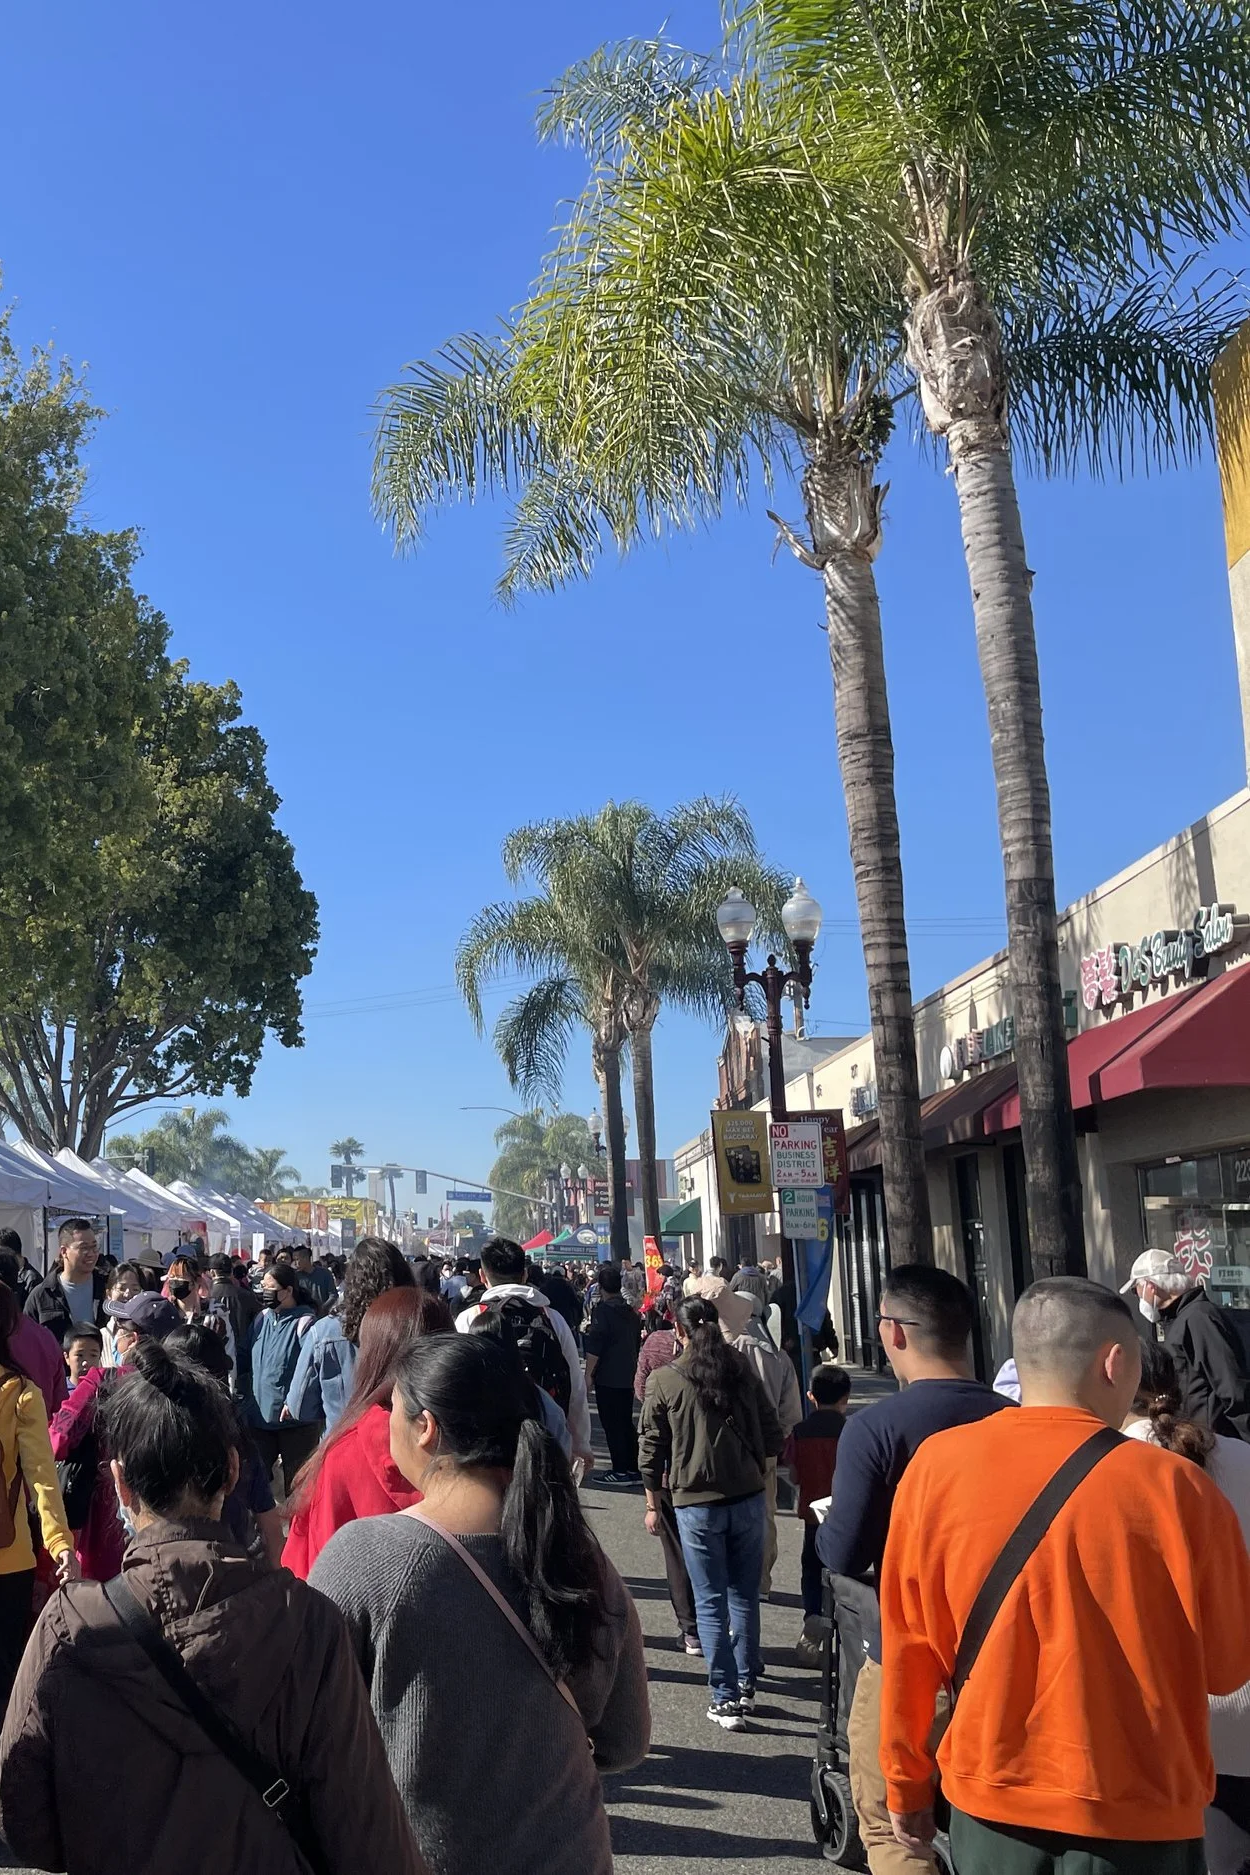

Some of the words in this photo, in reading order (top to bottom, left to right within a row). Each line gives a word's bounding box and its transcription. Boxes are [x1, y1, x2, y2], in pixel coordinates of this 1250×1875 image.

[1151, 929, 1192, 979] Beauty
[1194, 902, 1234, 959] Salon
[772, 1126, 787, 1138] NO
[773, 1140, 817, 1150] PARKING
[776, 1151, 816, 1159] BUSINESS
[777, 1160, 816, 1168] DISTRICT
[785, 1191, 793, 1203] 2
[796, 1195, 814, 1203] HOUR
[785, 1208, 815, 1218] PARKING
